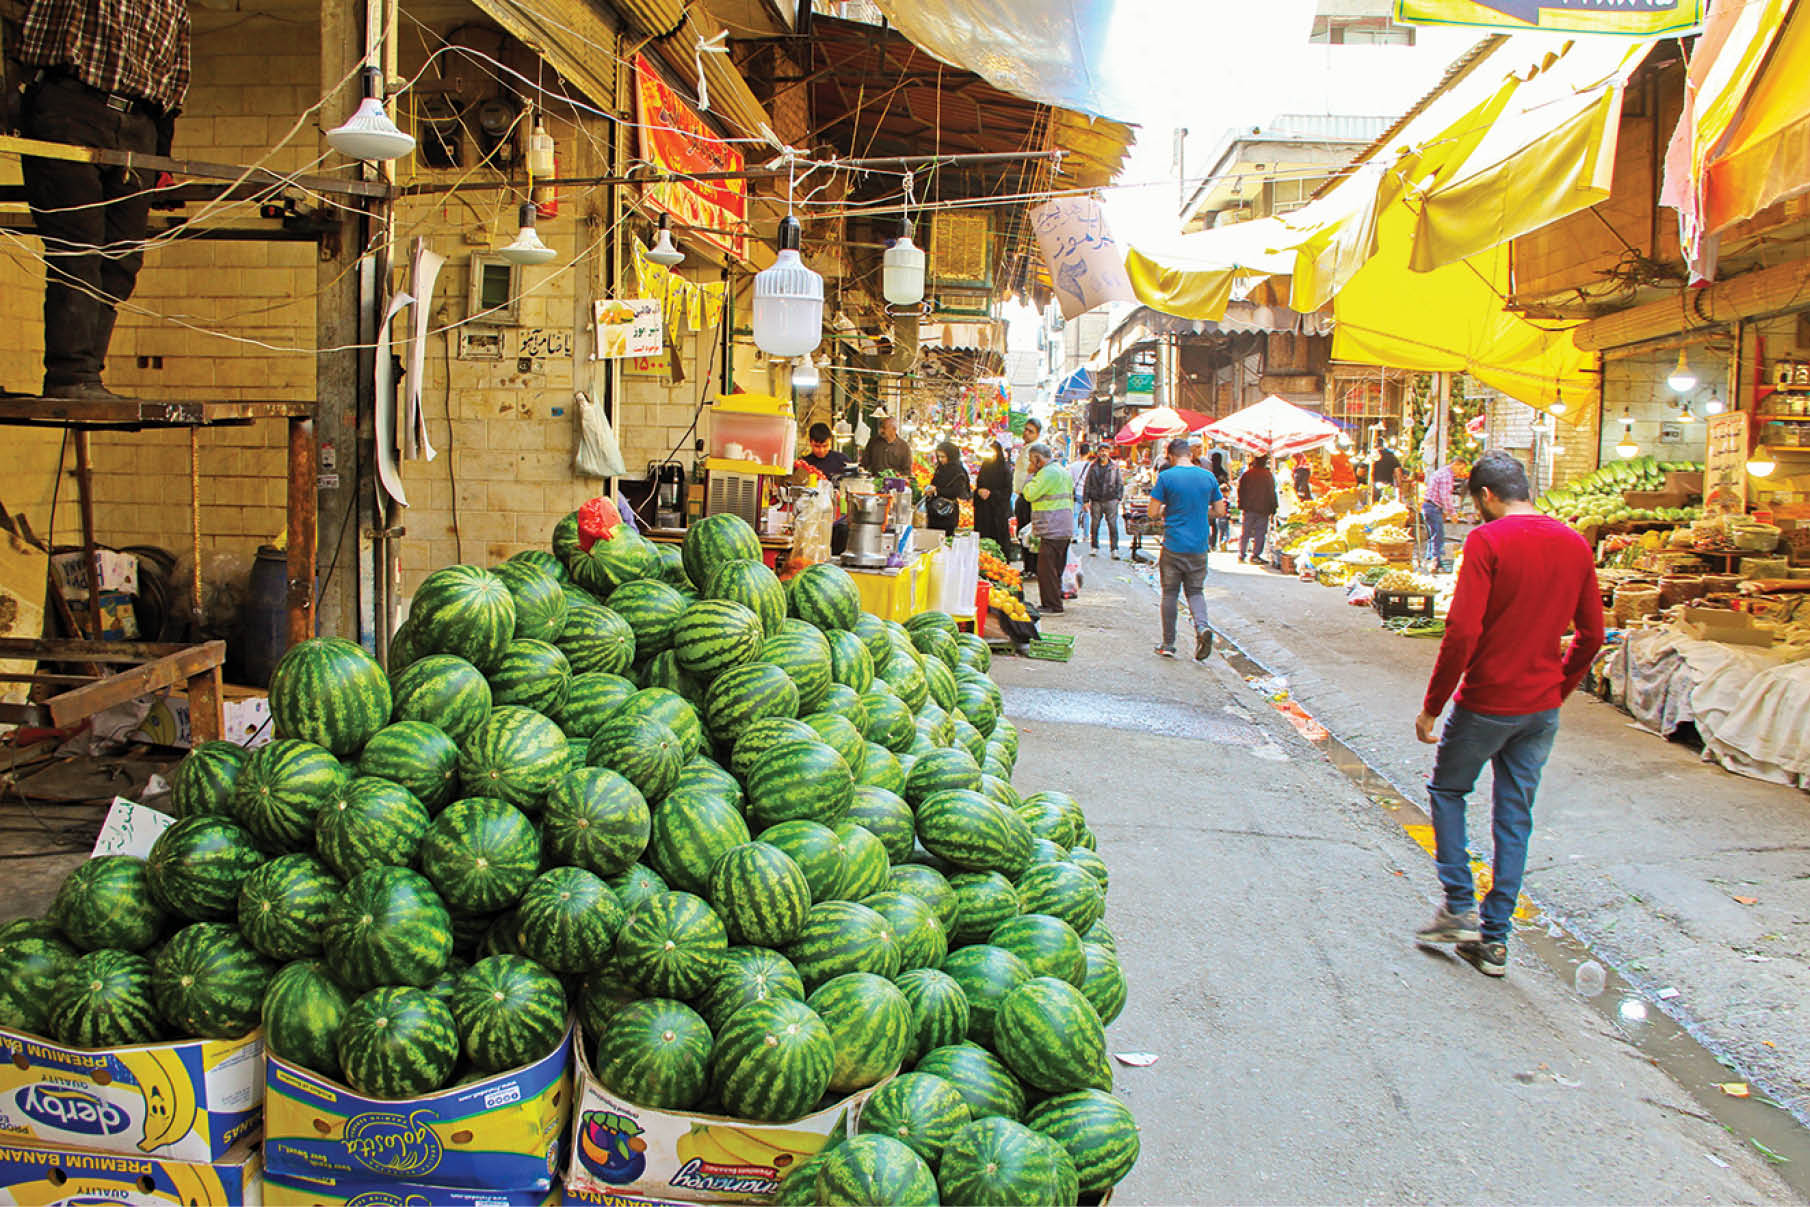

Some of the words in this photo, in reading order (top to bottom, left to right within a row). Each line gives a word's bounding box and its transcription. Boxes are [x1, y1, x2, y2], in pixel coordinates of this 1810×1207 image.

[27, 1042, 107, 1068] PREMIUM
[41, 1073, 89, 1090] QUALITY
[25, 1083, 121, 1135] derby
[340, 1108, 440, 1157] golosita
[0, 1149, 61, 1168] BANAN
[65, 1154, 153, 1175] PREMIUM
[76, 1185, 130, 1199] QUALITY
